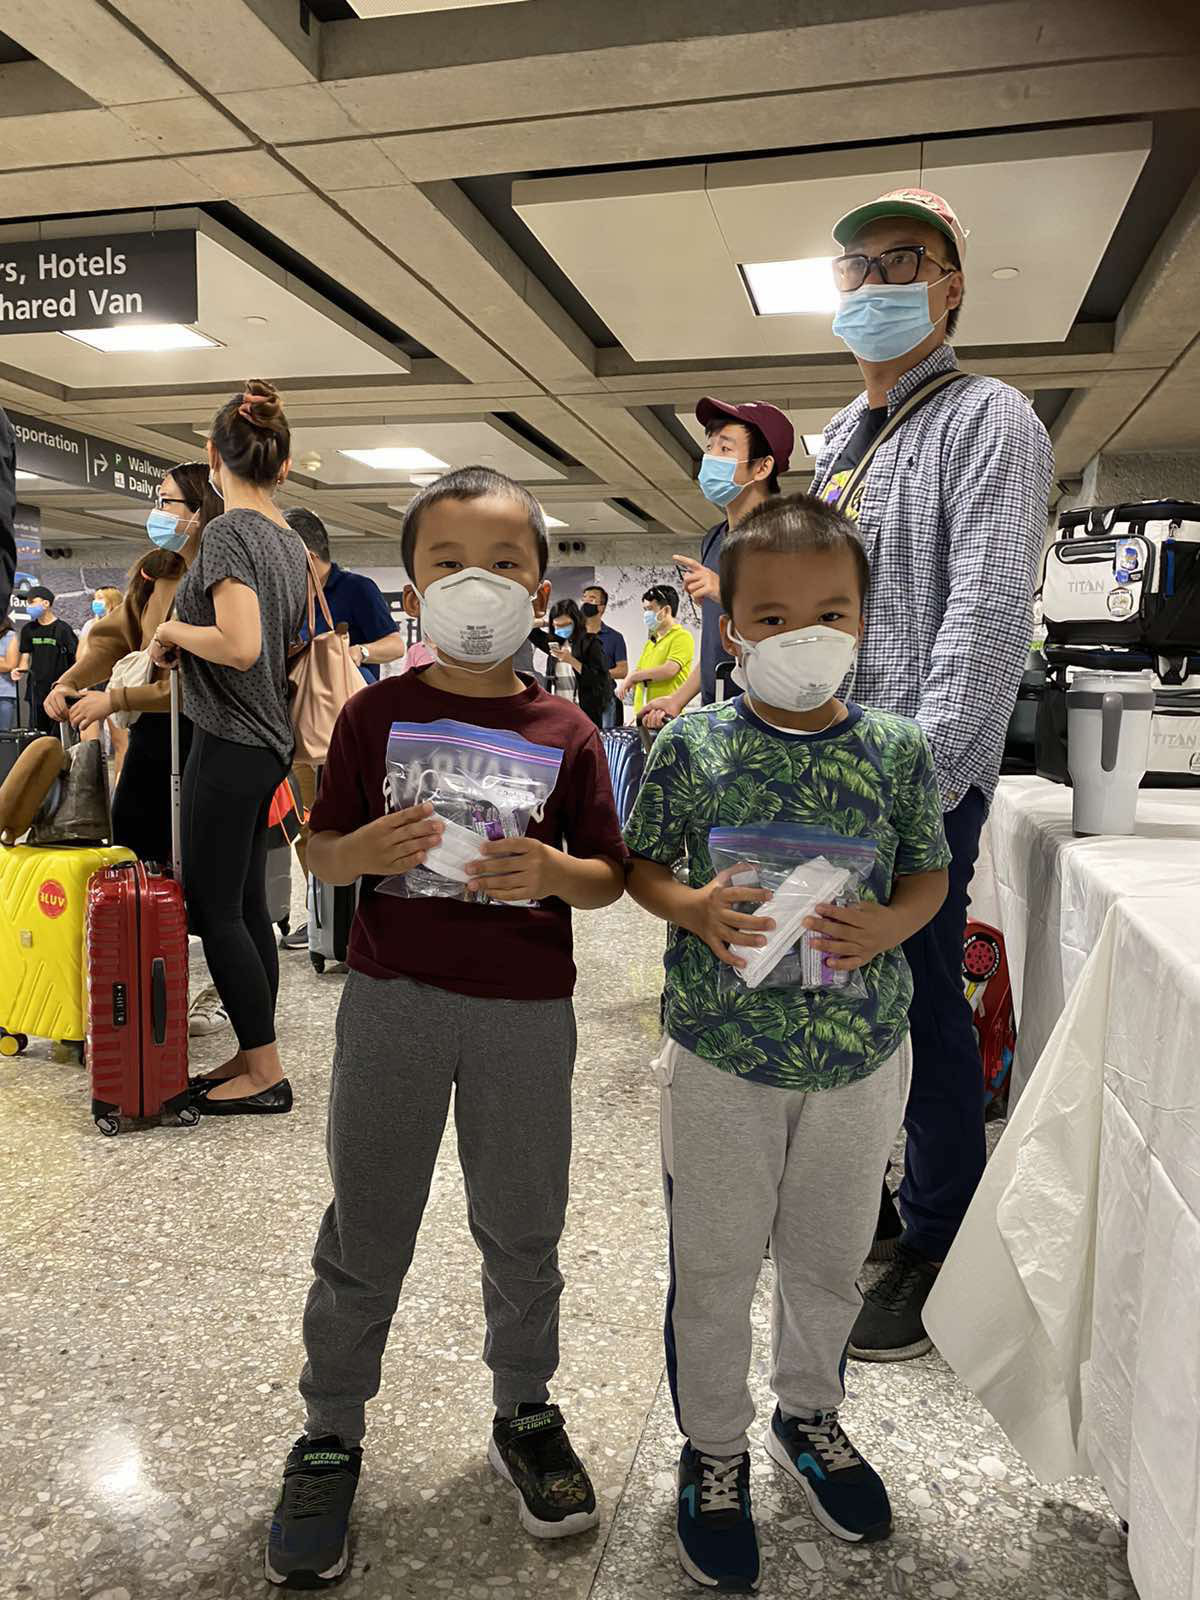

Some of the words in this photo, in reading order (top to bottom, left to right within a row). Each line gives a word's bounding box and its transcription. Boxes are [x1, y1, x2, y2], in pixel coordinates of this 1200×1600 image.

[39, 246, 127, 280] Hotels
[0, 289, 76, 320] hared
[88, 289, 142, 316] Van
[128, 456, 167, 478] Walkwa
[129, 476, 153, 498] Daily
[1067, 580, 1105, 593] TITAN
[1153, 733, 1197, 746] TITAN
[303, 1452, 350, 1462] SKECHERS
